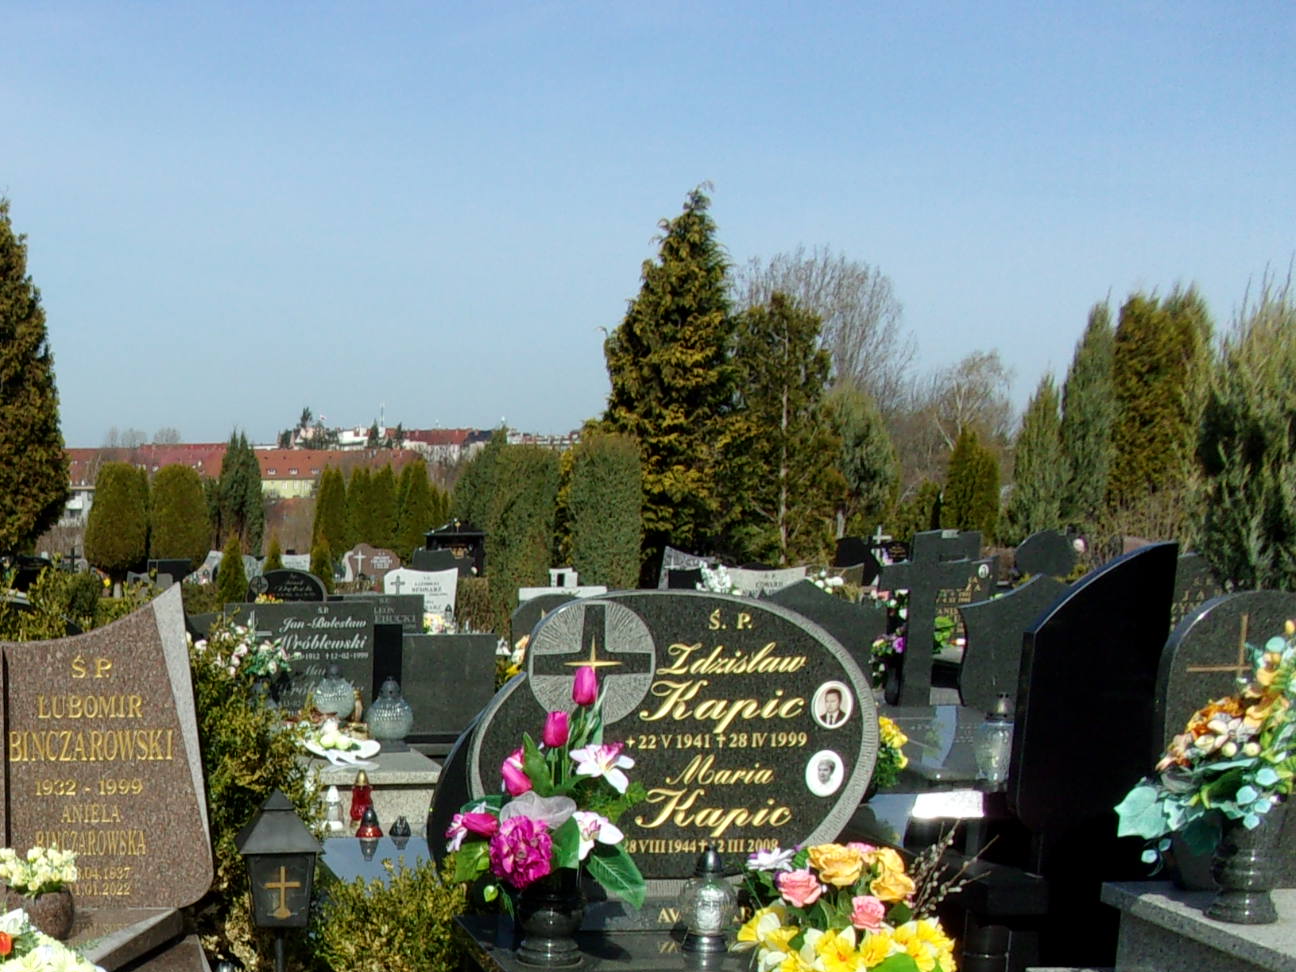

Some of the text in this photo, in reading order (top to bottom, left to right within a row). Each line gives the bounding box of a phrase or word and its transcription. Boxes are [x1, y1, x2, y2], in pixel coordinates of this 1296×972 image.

[708, 609, 753, 631] Ś. P.
[282, 633, 368, 650] Wróblewski
[37, 694, 143, 719] LUBOMIR
[639, 679, 806, 734] Kapic
[9, 729, 174, 762] BINCZAROWSKI
[638, 731, 808, 750] 22 V 1941 28 IV 1999
[665, 753, 775, 786] Maria
[35, 779, 77, 796] 1932
[99, 778, 144, 796] 1999
[60, 803, 122, 823] ANIELA
[634, 787, 793, 838] Kapic
[639, 839, 665, 854] VIII
[667, 839, 697, 854] 1944
[727, 840, 745, 854] III
